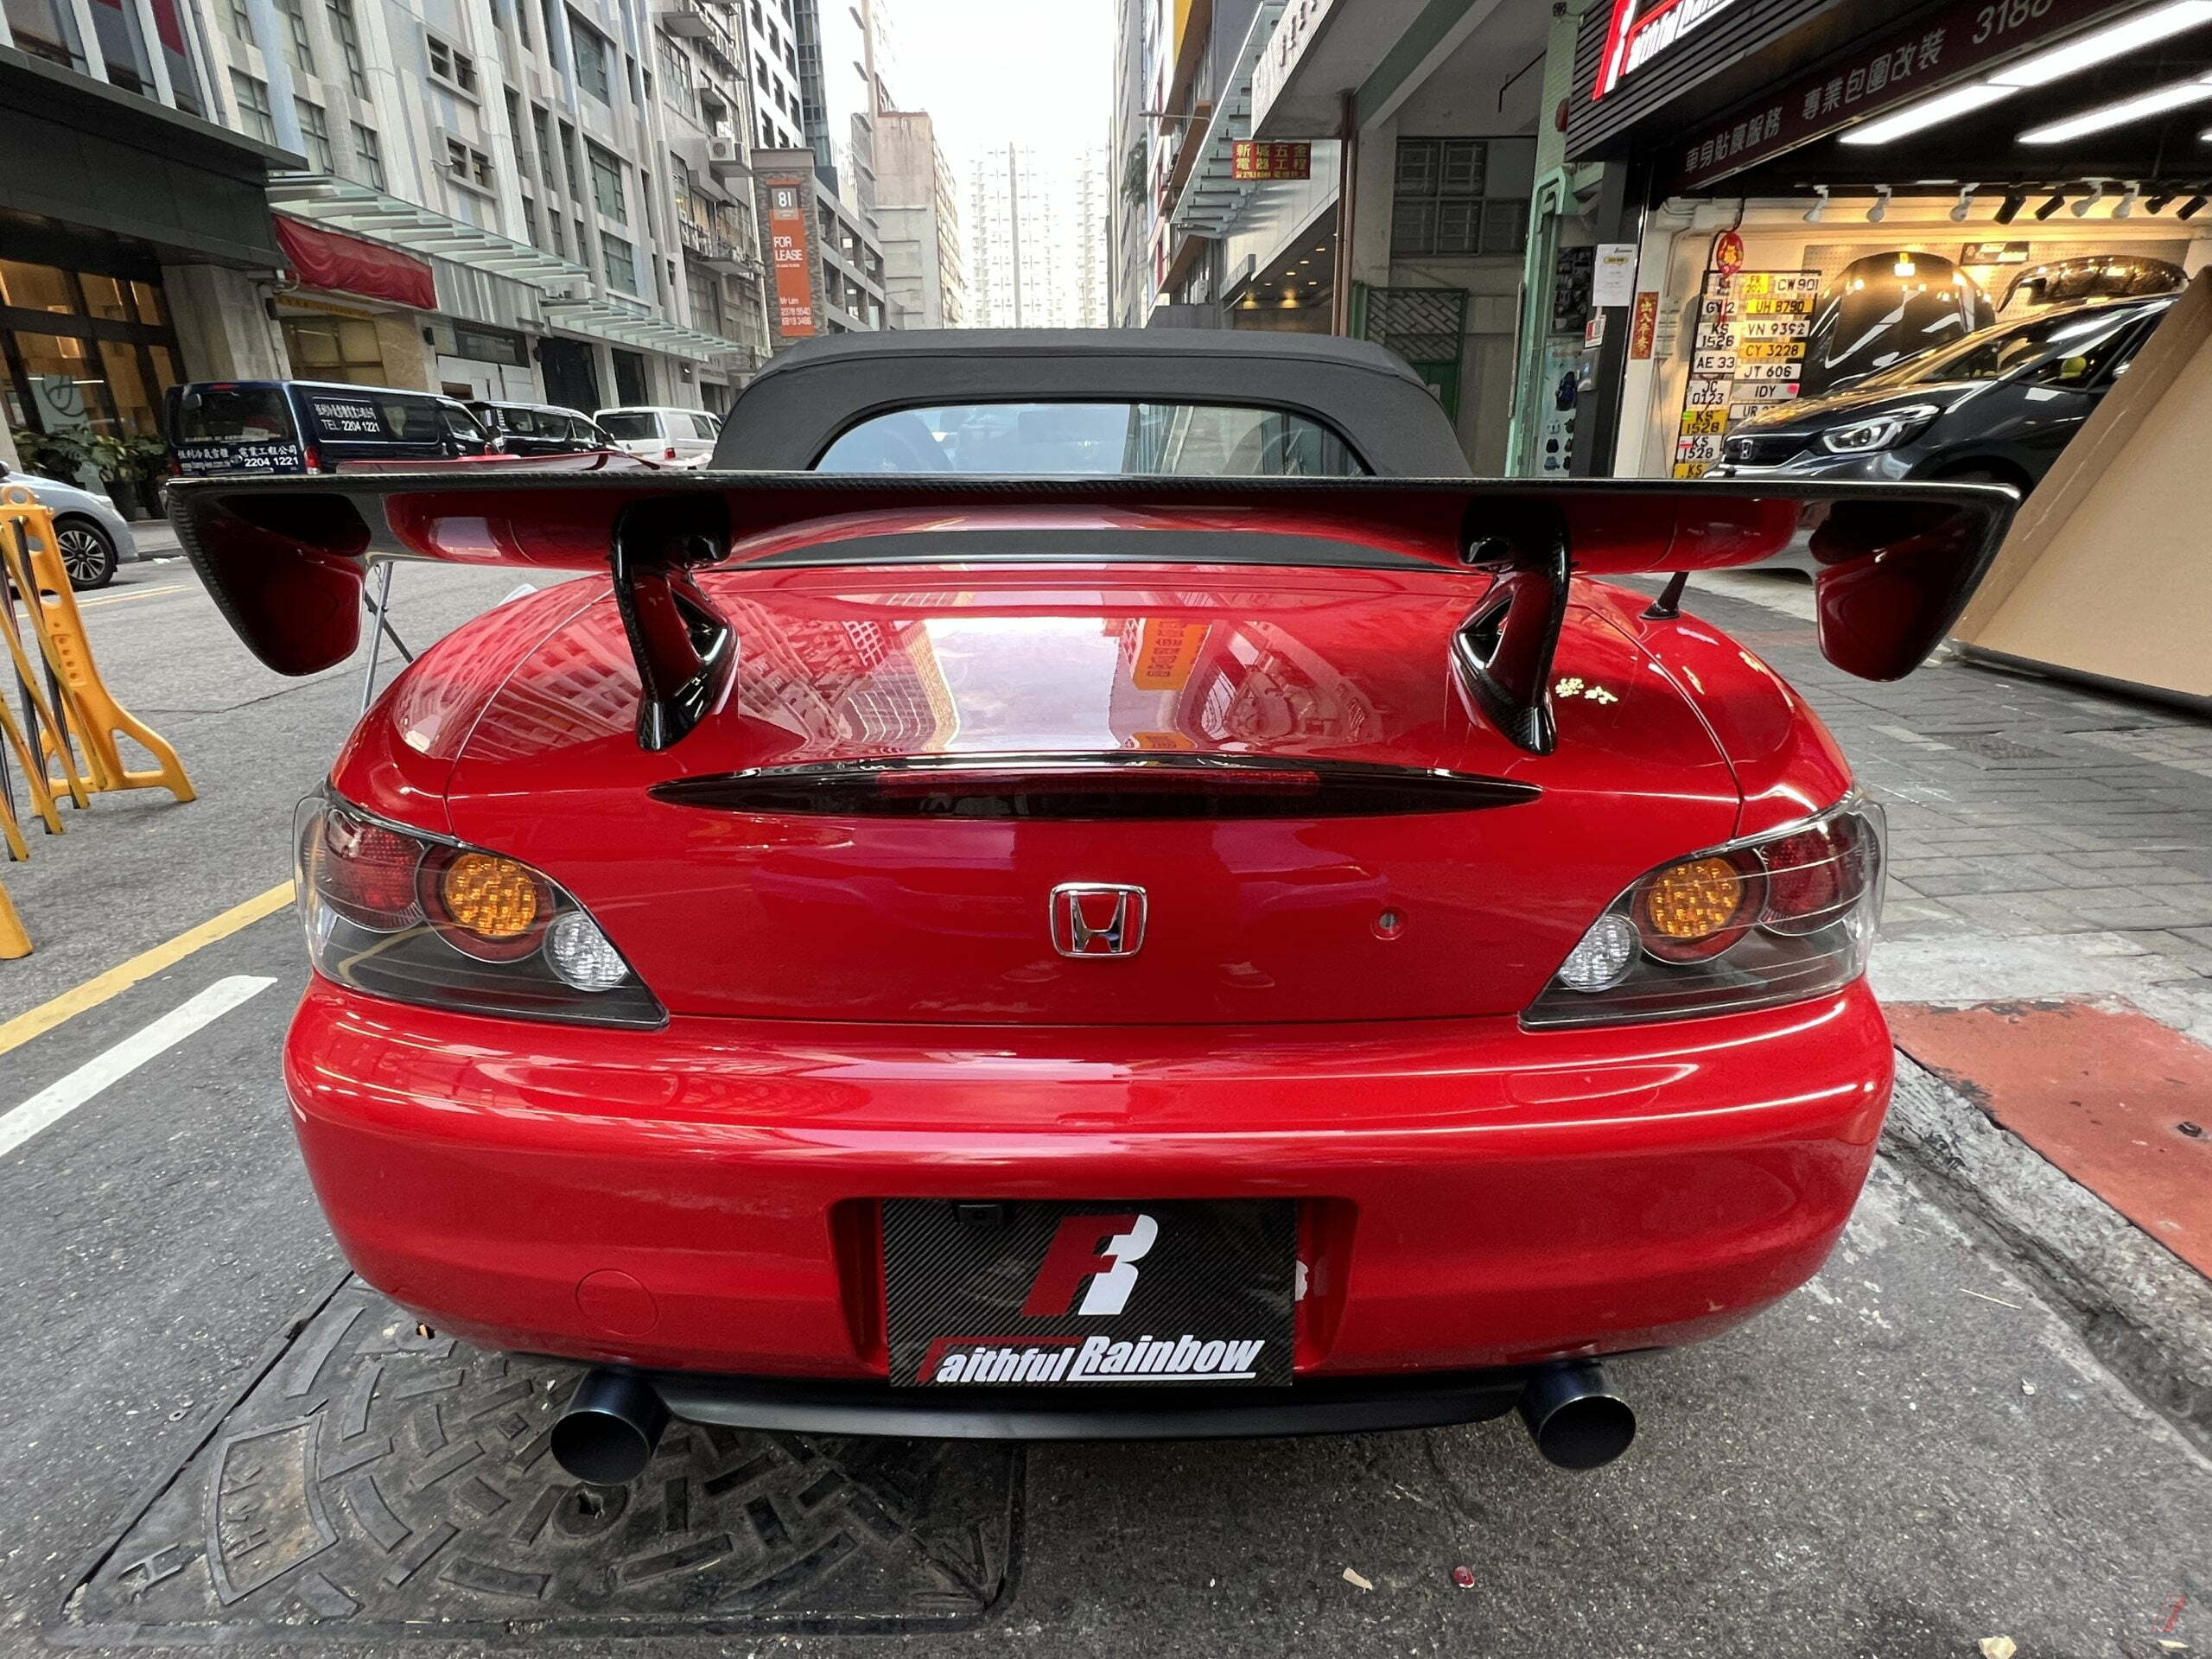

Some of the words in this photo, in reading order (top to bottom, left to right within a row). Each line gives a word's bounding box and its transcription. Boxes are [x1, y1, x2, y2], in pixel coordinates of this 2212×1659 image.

[773, 236, 792, 249] FOR
[774, 249, 804, 262] LEASE
[1777, 278, 1796, 289] CW
[1797, 278, 1819, 289] 901
[1756, 302, 1771, 313] UH
[1712, 323, 1730, 334] KS
[1748, 323, 1765, 335] VN
[1745, 344, 1761, 356] CY
[1766, 344, 1799, 356] 3228
[1696, 357, 1715, 369] AE
[1718, 356, 1735, 368] 33
[1744, 365, 1762, 378] JT
[1702, 380, 1718, 393] JC
[1692, 392, 1724, 405] 0123
[1695, 410, 1713, 423] KS
[1743, 406, 1758, 417] UR
[341, 420, 361, 432] 2204
[361, 421, 380, 433] 1221
[1687, 422, 1719, 434] 1528
[1692, 436, 1710, 448] KS
[1682, 448, 1713, 460] 1528
[244, 457, 270, 467] 2204
[273, 455, 299, 466] 1221
[1688, 464, 1703, 476] KS
[916, 1336, 1084, 1382] Faithful
[1067, 1334, 1265, 1381] Rainbow
